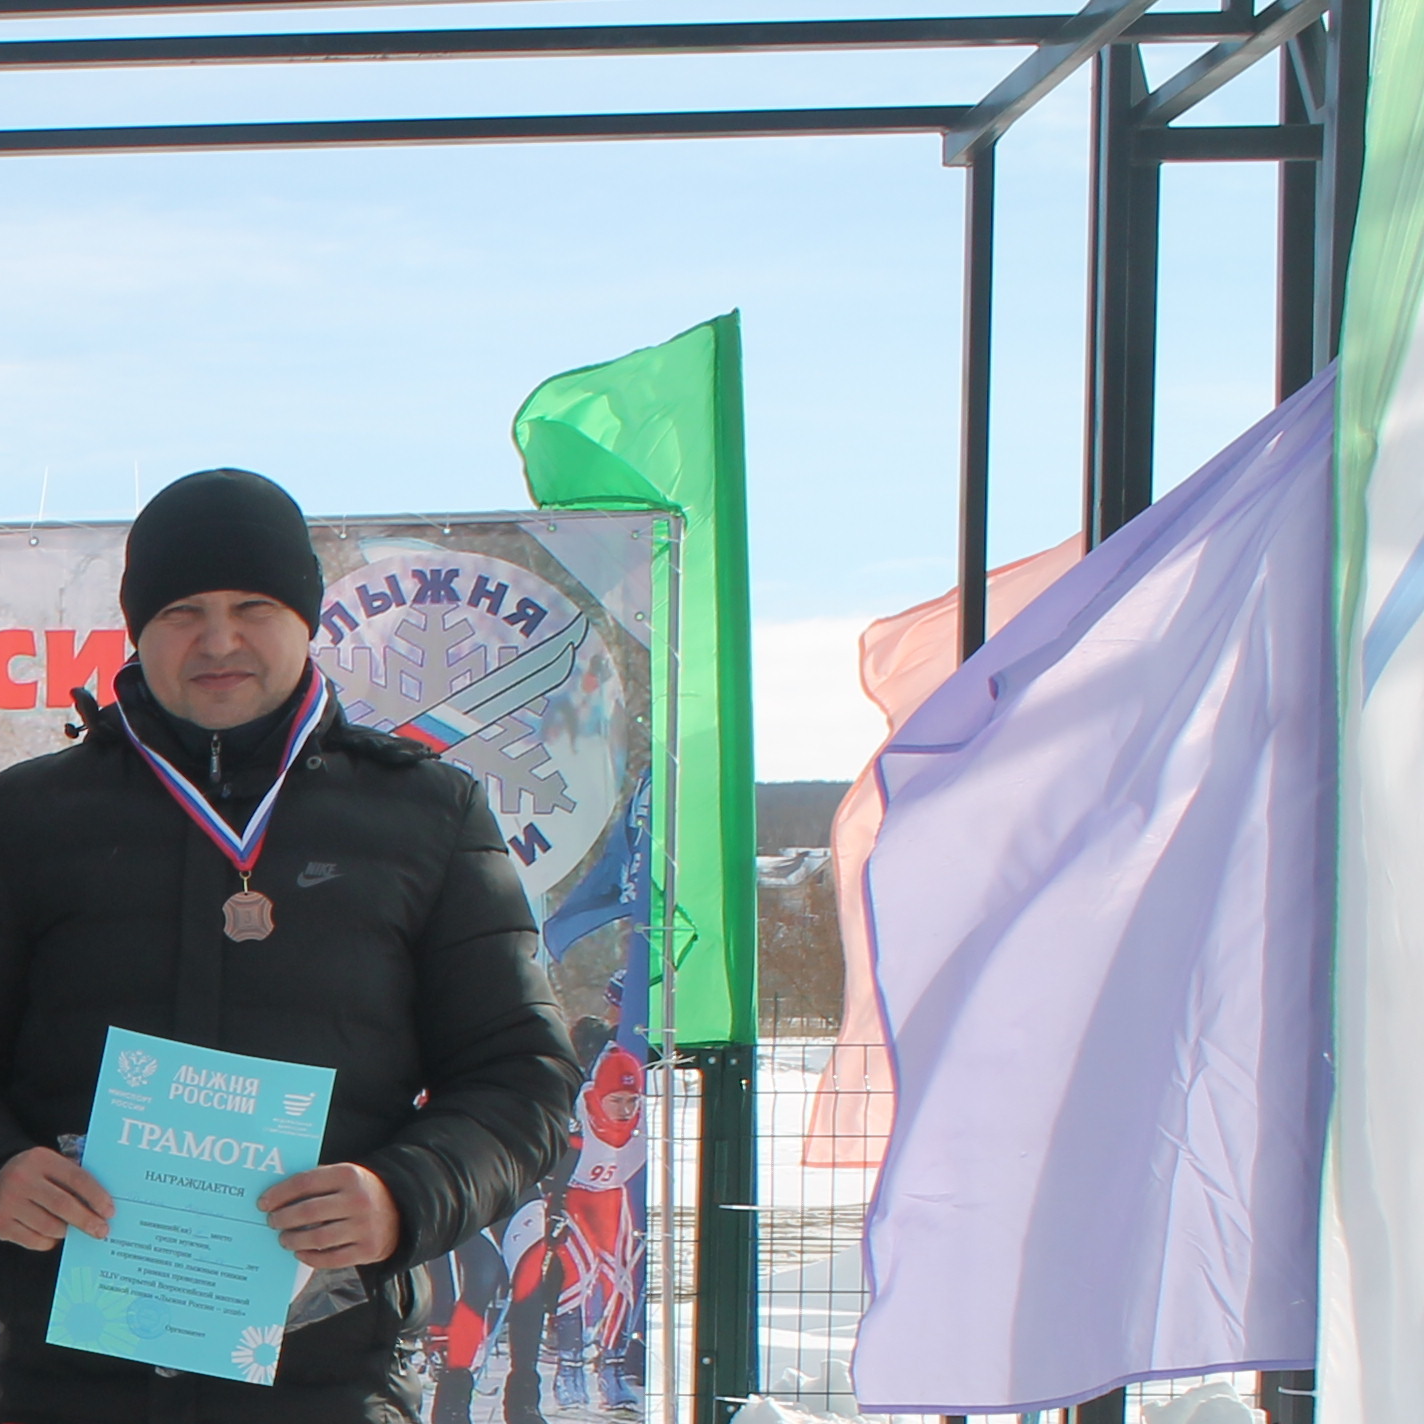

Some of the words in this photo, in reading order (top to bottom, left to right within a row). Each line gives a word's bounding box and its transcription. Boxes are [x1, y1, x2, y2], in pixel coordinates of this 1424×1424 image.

[320, 568, 549, 646] ЛЫЖНЯ
[305, 861, 338, 875] NIKE
[173, 1065, 260, 1096] ЛЫЖНЯ
[169, 1083, 256, 1115] РОССИИ
[118, 1118, 285, 1174] ГРАМОТА
[145, 1170, 245, 1198] НАГРАЖДАЕТСЯ
